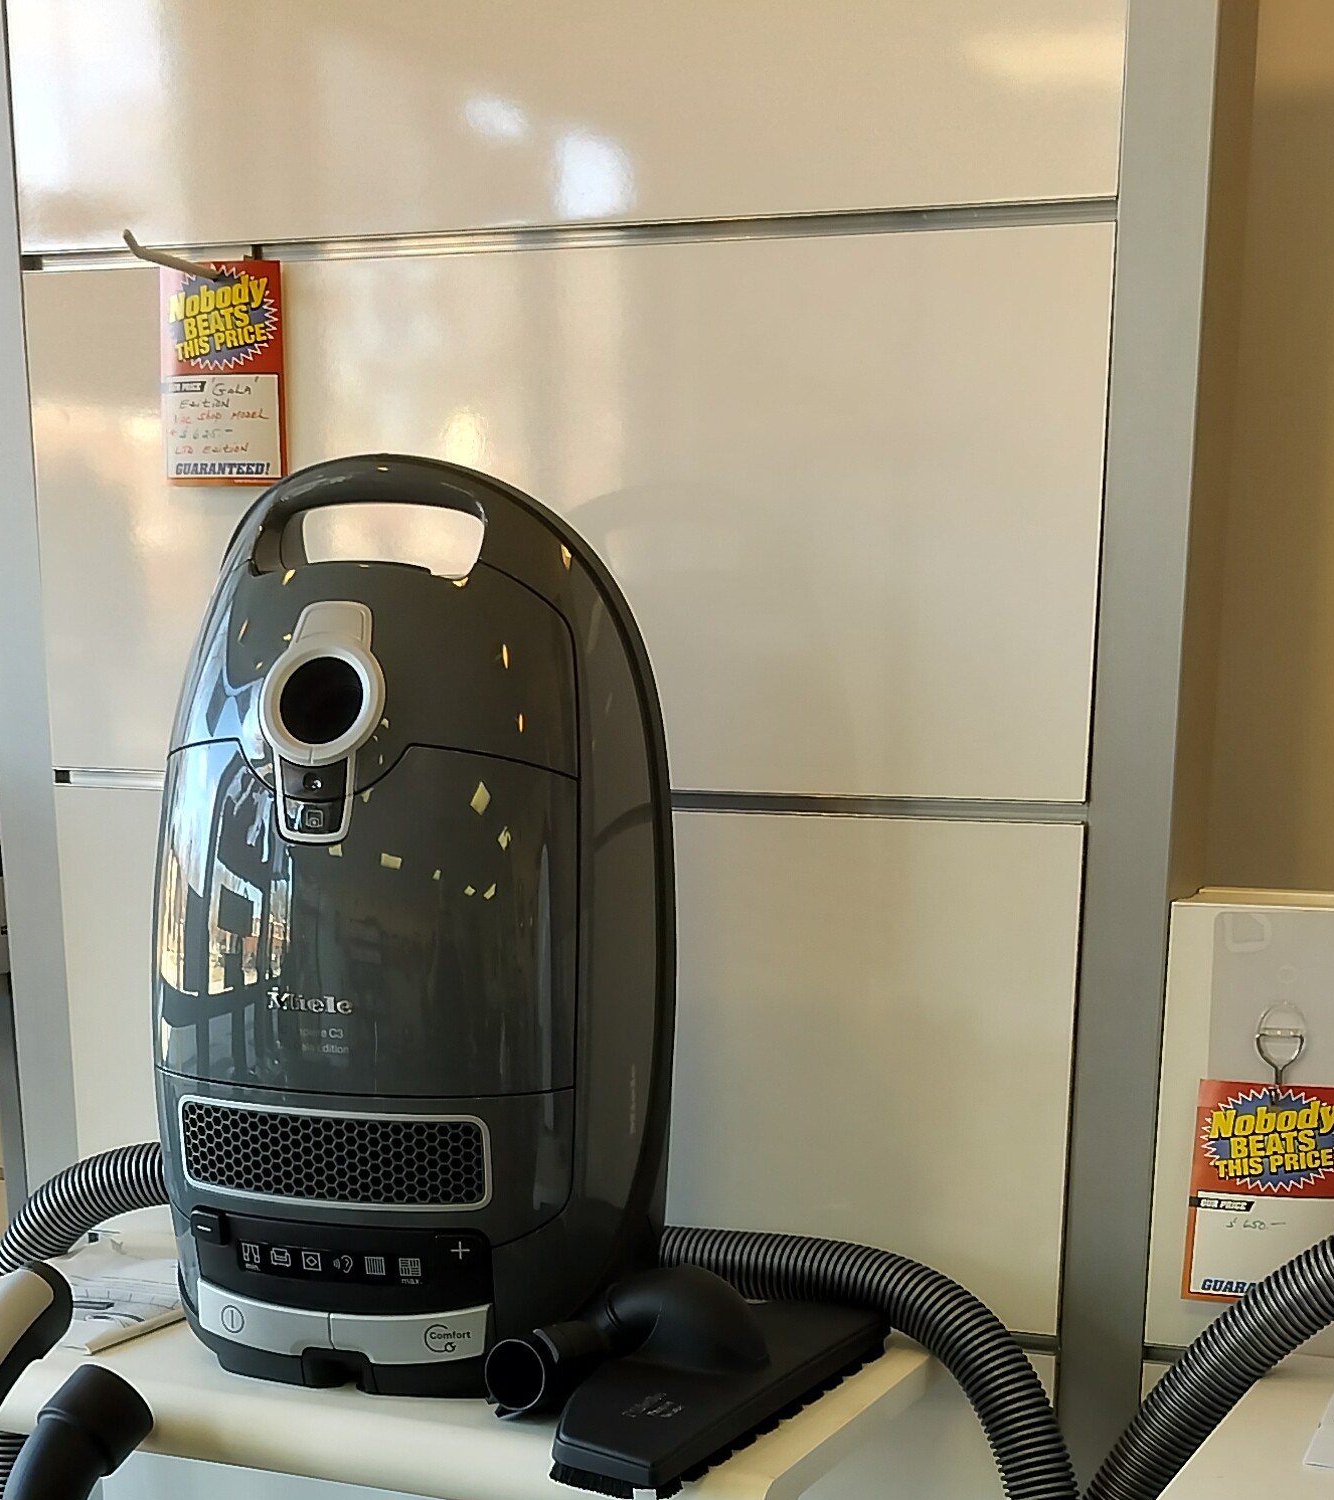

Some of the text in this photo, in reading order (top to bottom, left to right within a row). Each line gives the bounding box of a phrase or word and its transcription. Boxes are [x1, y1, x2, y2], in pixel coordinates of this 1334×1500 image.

[169, 274, 267, 323] Nobody
[184, 304, 250, 340] BEATS
[175, 323, 267, 360] THIS PRICE
[176, 462, 270, 475] GUARANTEED!
[267, 989, 353, 1014] Miele
[328, 1028, 344, 1038] C3
[319, 1043, 349, 1054] dition
[1230, 1130, 1316, 1158] BEATS
[1215, 1149, 1334, 1178] THIS PRICE
[1200, 1199, 1248, 1211] OUR PRICE
[429, 1329, 471, 1341] Comfort
